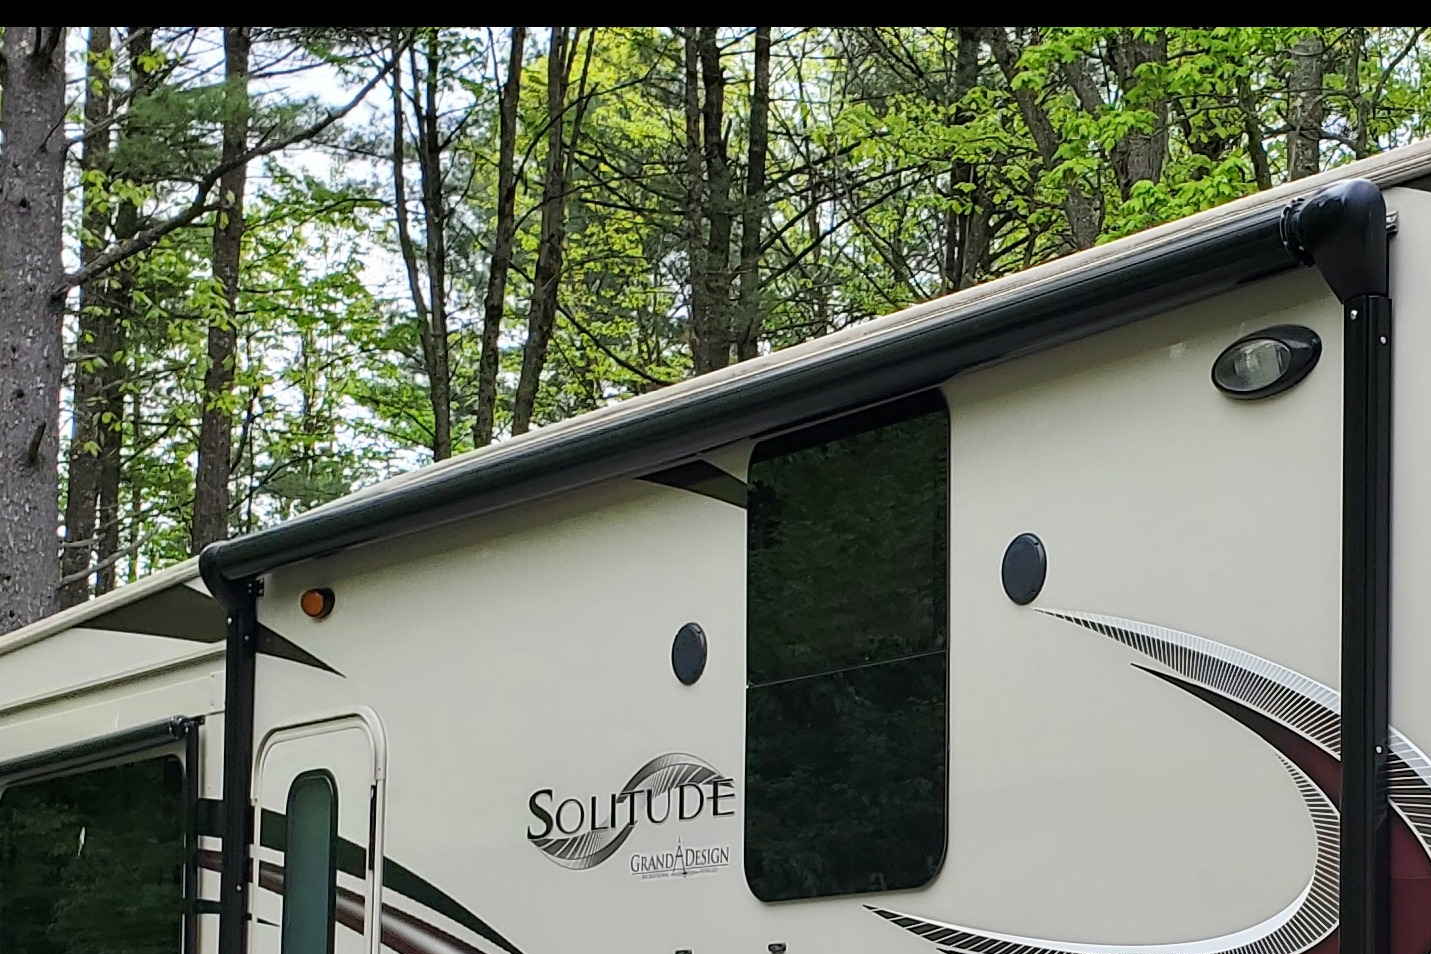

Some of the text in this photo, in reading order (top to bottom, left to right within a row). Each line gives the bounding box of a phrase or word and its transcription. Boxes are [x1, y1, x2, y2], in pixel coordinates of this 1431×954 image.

[527, 778, 736, 840] SOLITUDE
[630, 846, 730, 873] GRAND DESIGN
